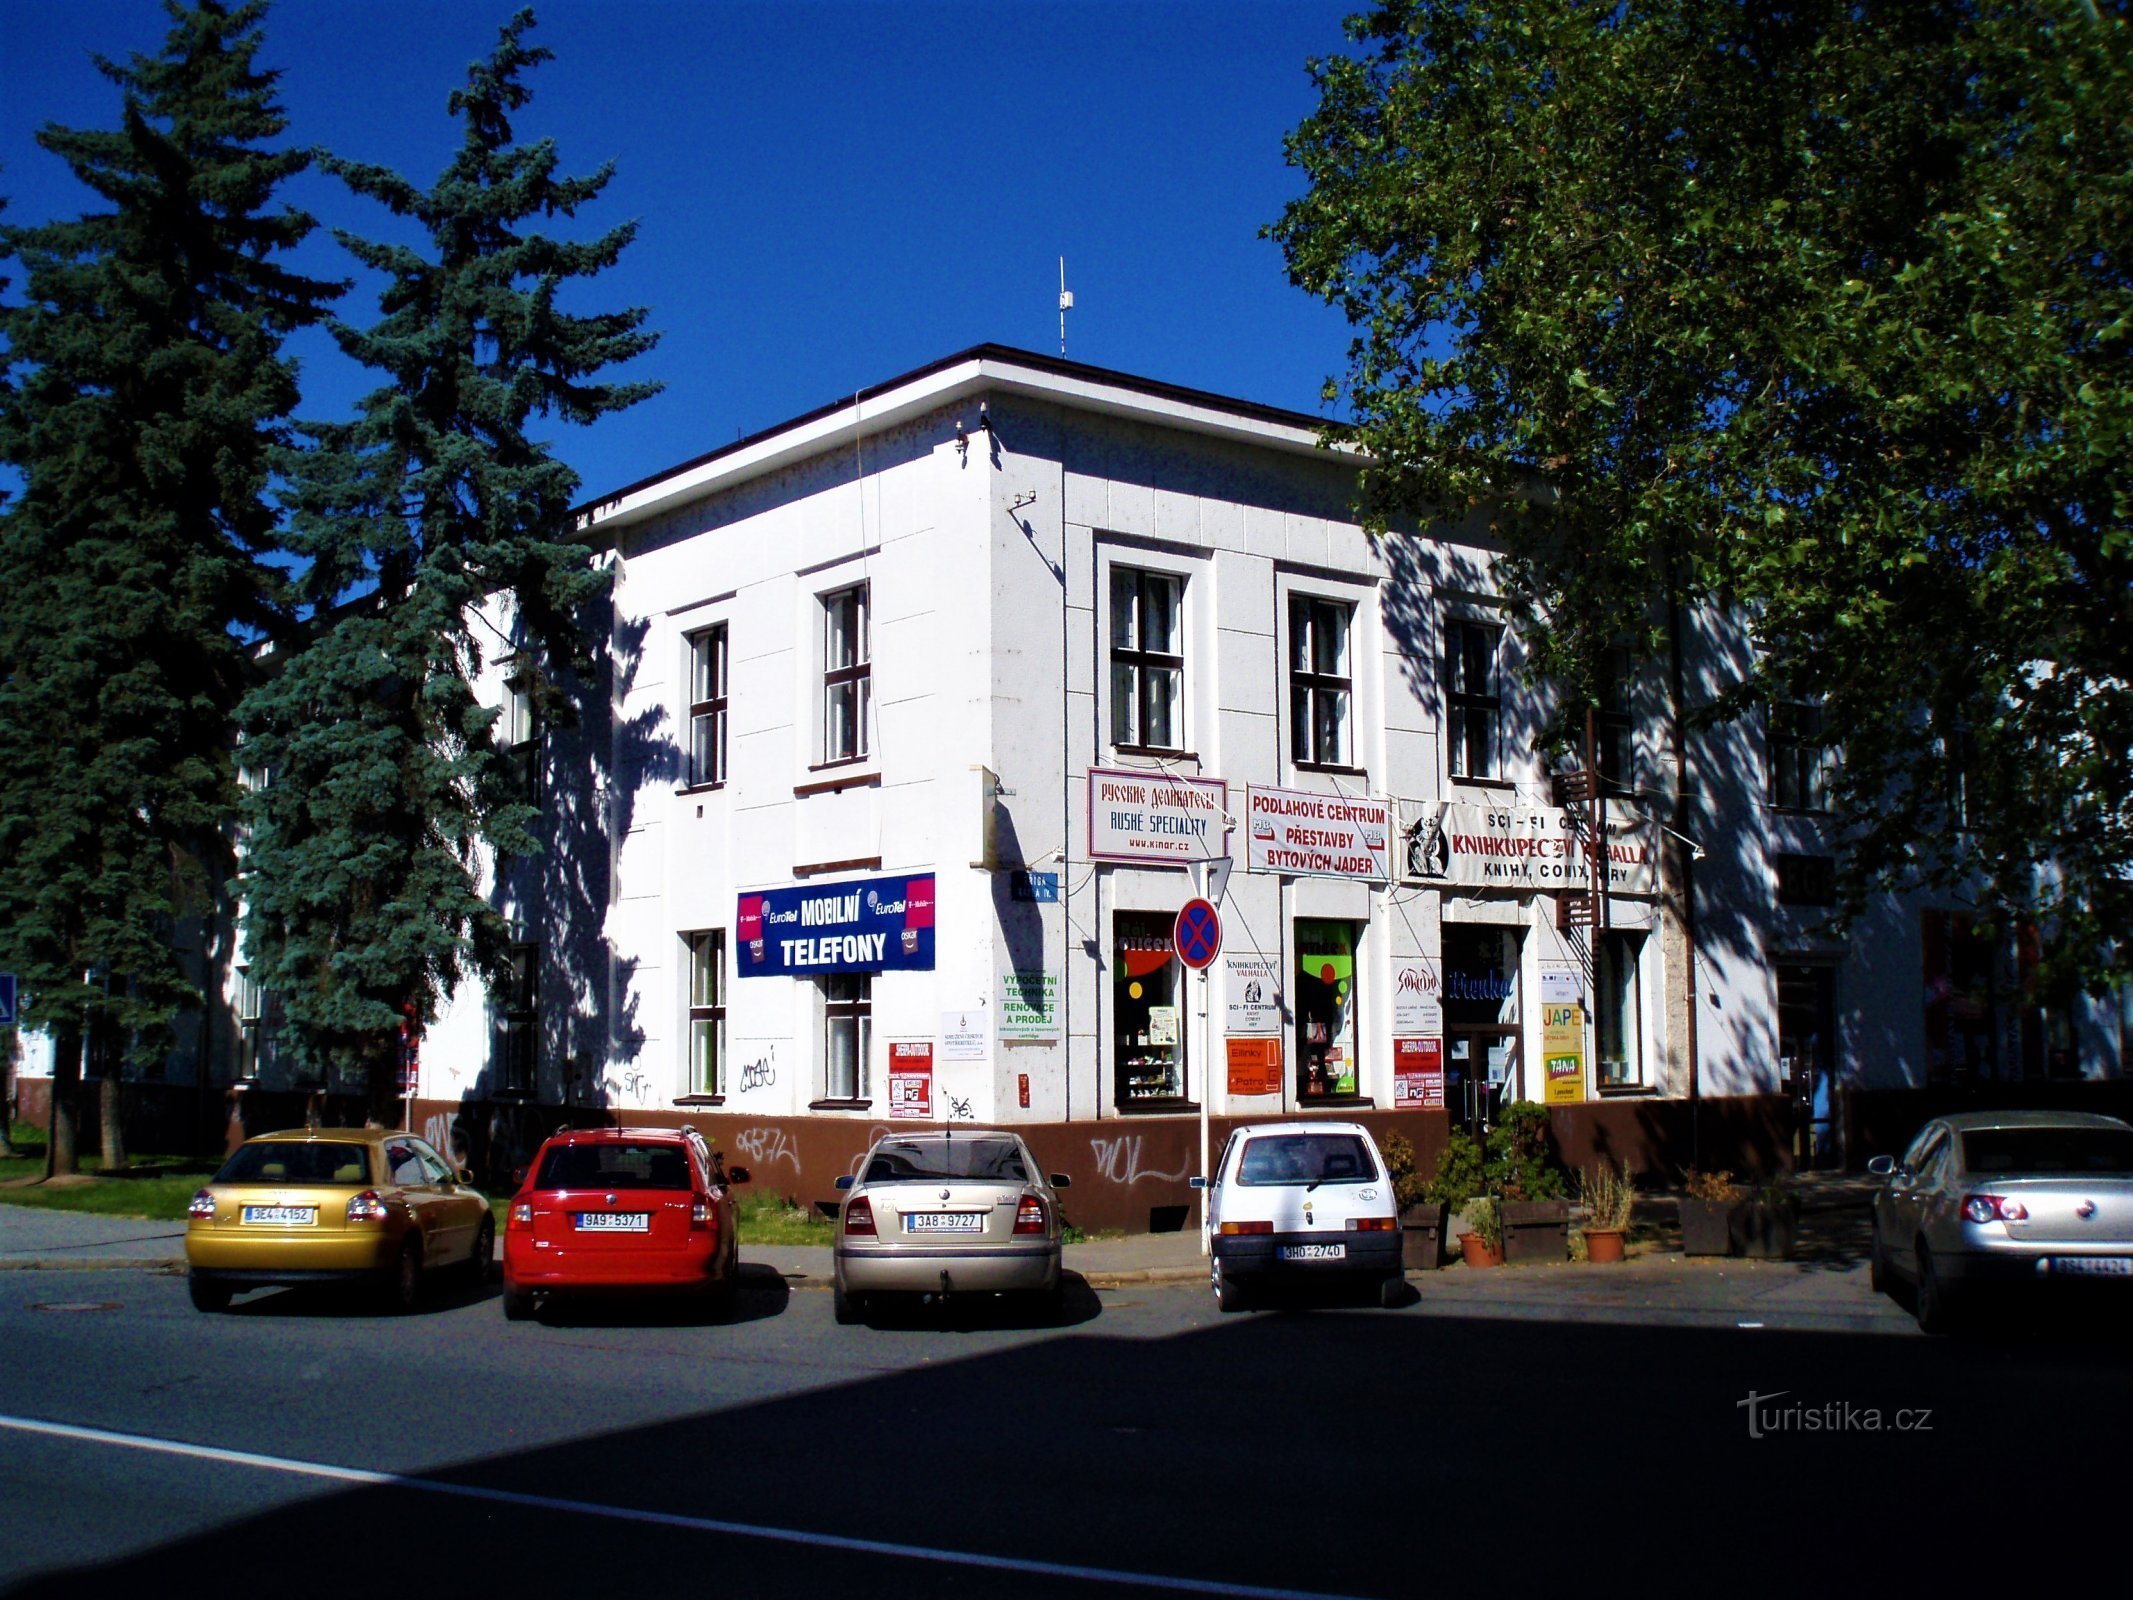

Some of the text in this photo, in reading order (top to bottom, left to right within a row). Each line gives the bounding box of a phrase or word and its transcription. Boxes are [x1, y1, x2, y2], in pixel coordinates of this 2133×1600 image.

[1101, 783, 1146, 804] РУССКИЕ
[1253, 795, 1385, 824] PODLAHOVÉ CENTRUM
[1150, 815, 1207, 836] SPECIALITY
[1488, 814, 1510, 828] SCI
[1286, 824, 1354, 849] PŘESTAVBY
[1267, 849, 1373, 874] BYTOVÝCH JADER
[801, 888, 862, 926] MOBILNÍ
[781, 933, 886, 966] TELEFONY
[1236, 969, 1268, 978] VALHALLA
[1006, 988, 1054, 997] TECHNIKA
[1004, 1003, 1054, 1012] RENOVACE
[1006, 1015, 1052, 1024] A PRODEJ
[1544, 1008, 1581, 1027] JAPE
[1551, 1059, 1576, 1074] TANA
[254, 1208, 307, 1220] 3E4 4152
[586, 1215, 642, 1226] 9A9 5371
[918, 1215, 976, 1227] 3A8 9727
[1314, 1246, 1340, 1257] 2740
